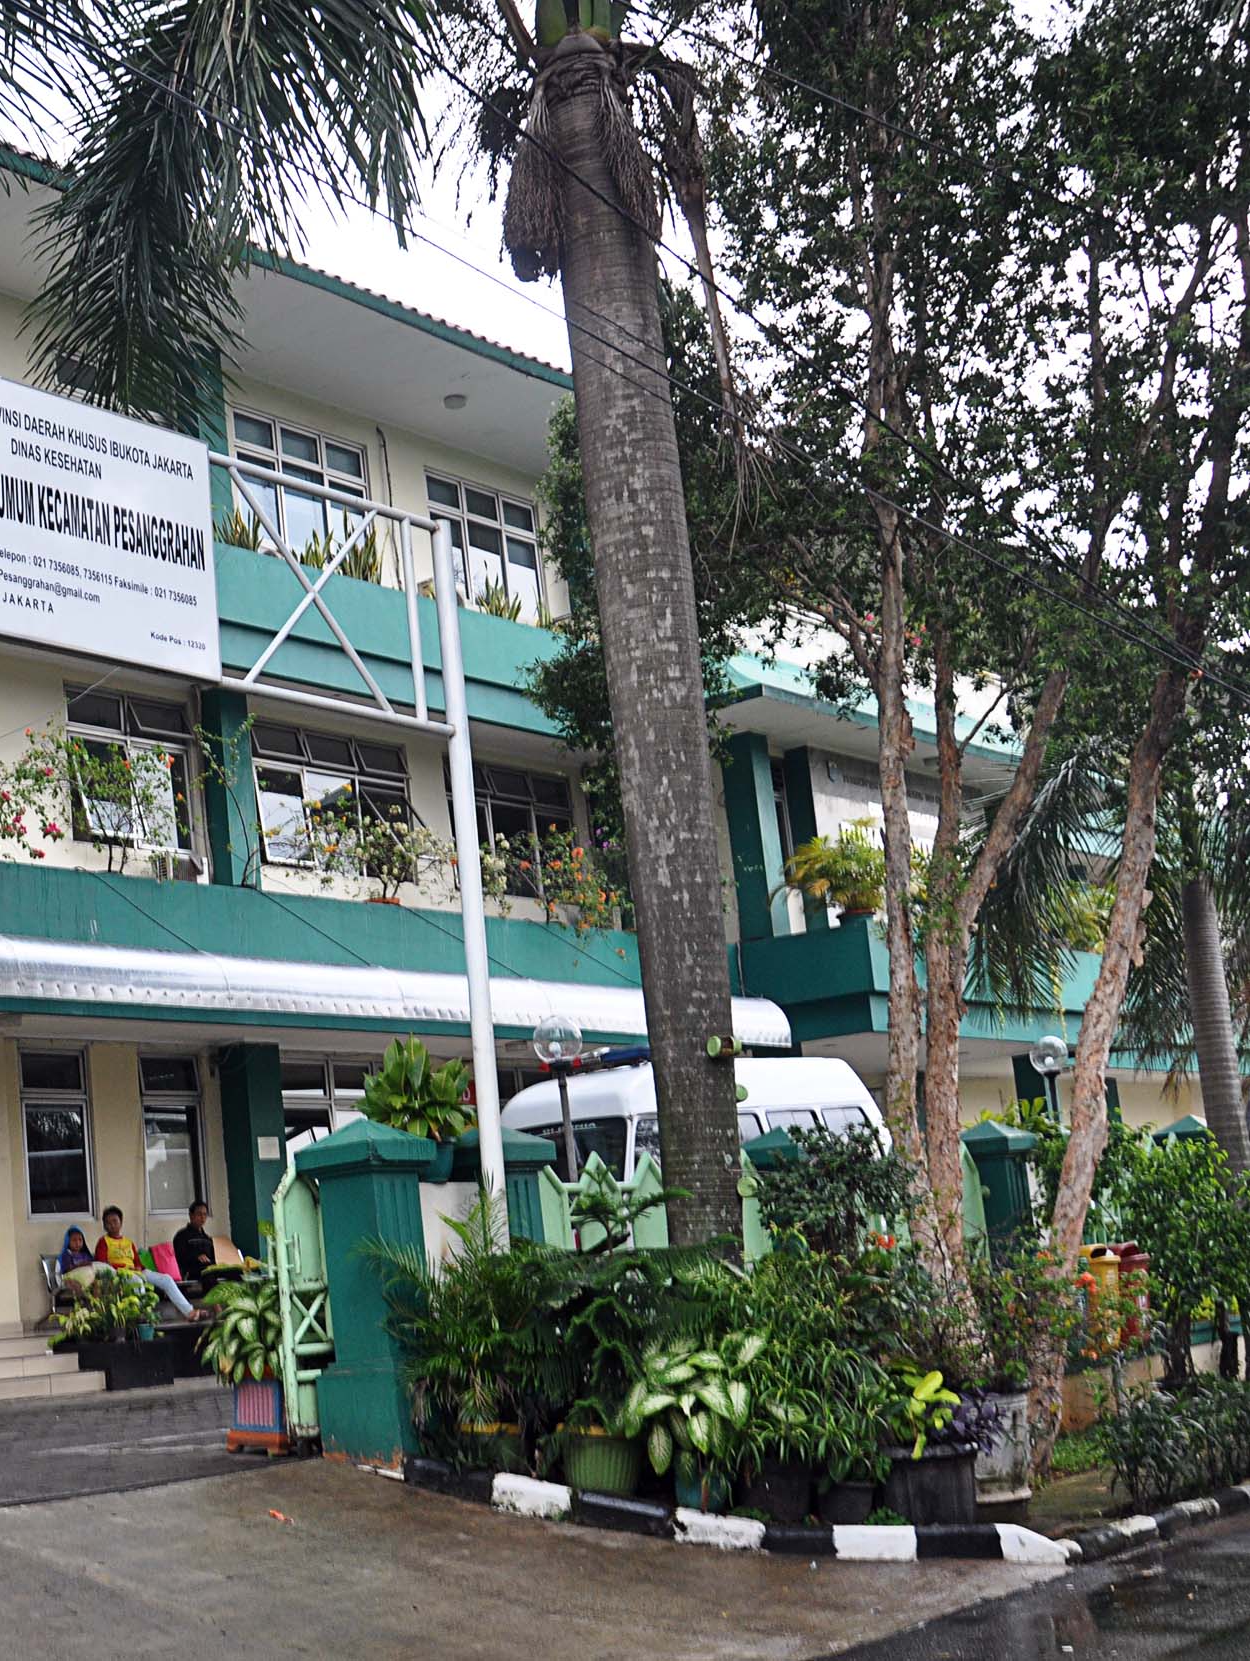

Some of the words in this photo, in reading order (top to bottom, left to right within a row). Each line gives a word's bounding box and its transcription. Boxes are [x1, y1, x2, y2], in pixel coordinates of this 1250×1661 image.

[11, 438, 41, 462] DINAS
[44, 447, 102, 480] KESEHATAN
[24, 414, 65, 442] DAERAH
[68, 428, 107, 454] KHUSUS
[110, 438, 150, 467] IBUKOTA
[152, 453, 193, 480] JAKARTA
[38, 483, 110, 547] KECAMATAN
[114, 505, 205, 572] PESANGGRAHAN
[33, 555, 47, 568] 021
[49, 559, 82, 579] 7356085,
[84, 568, 113, 586] 7356115
[114, 576, 148, 595] Faksimile
[154, 588, 167, 599] 021
[169, 590, 197, 607] 7356085
[150, 631, 167, 643] Kode
[169, 635, 181, 645] Pos
